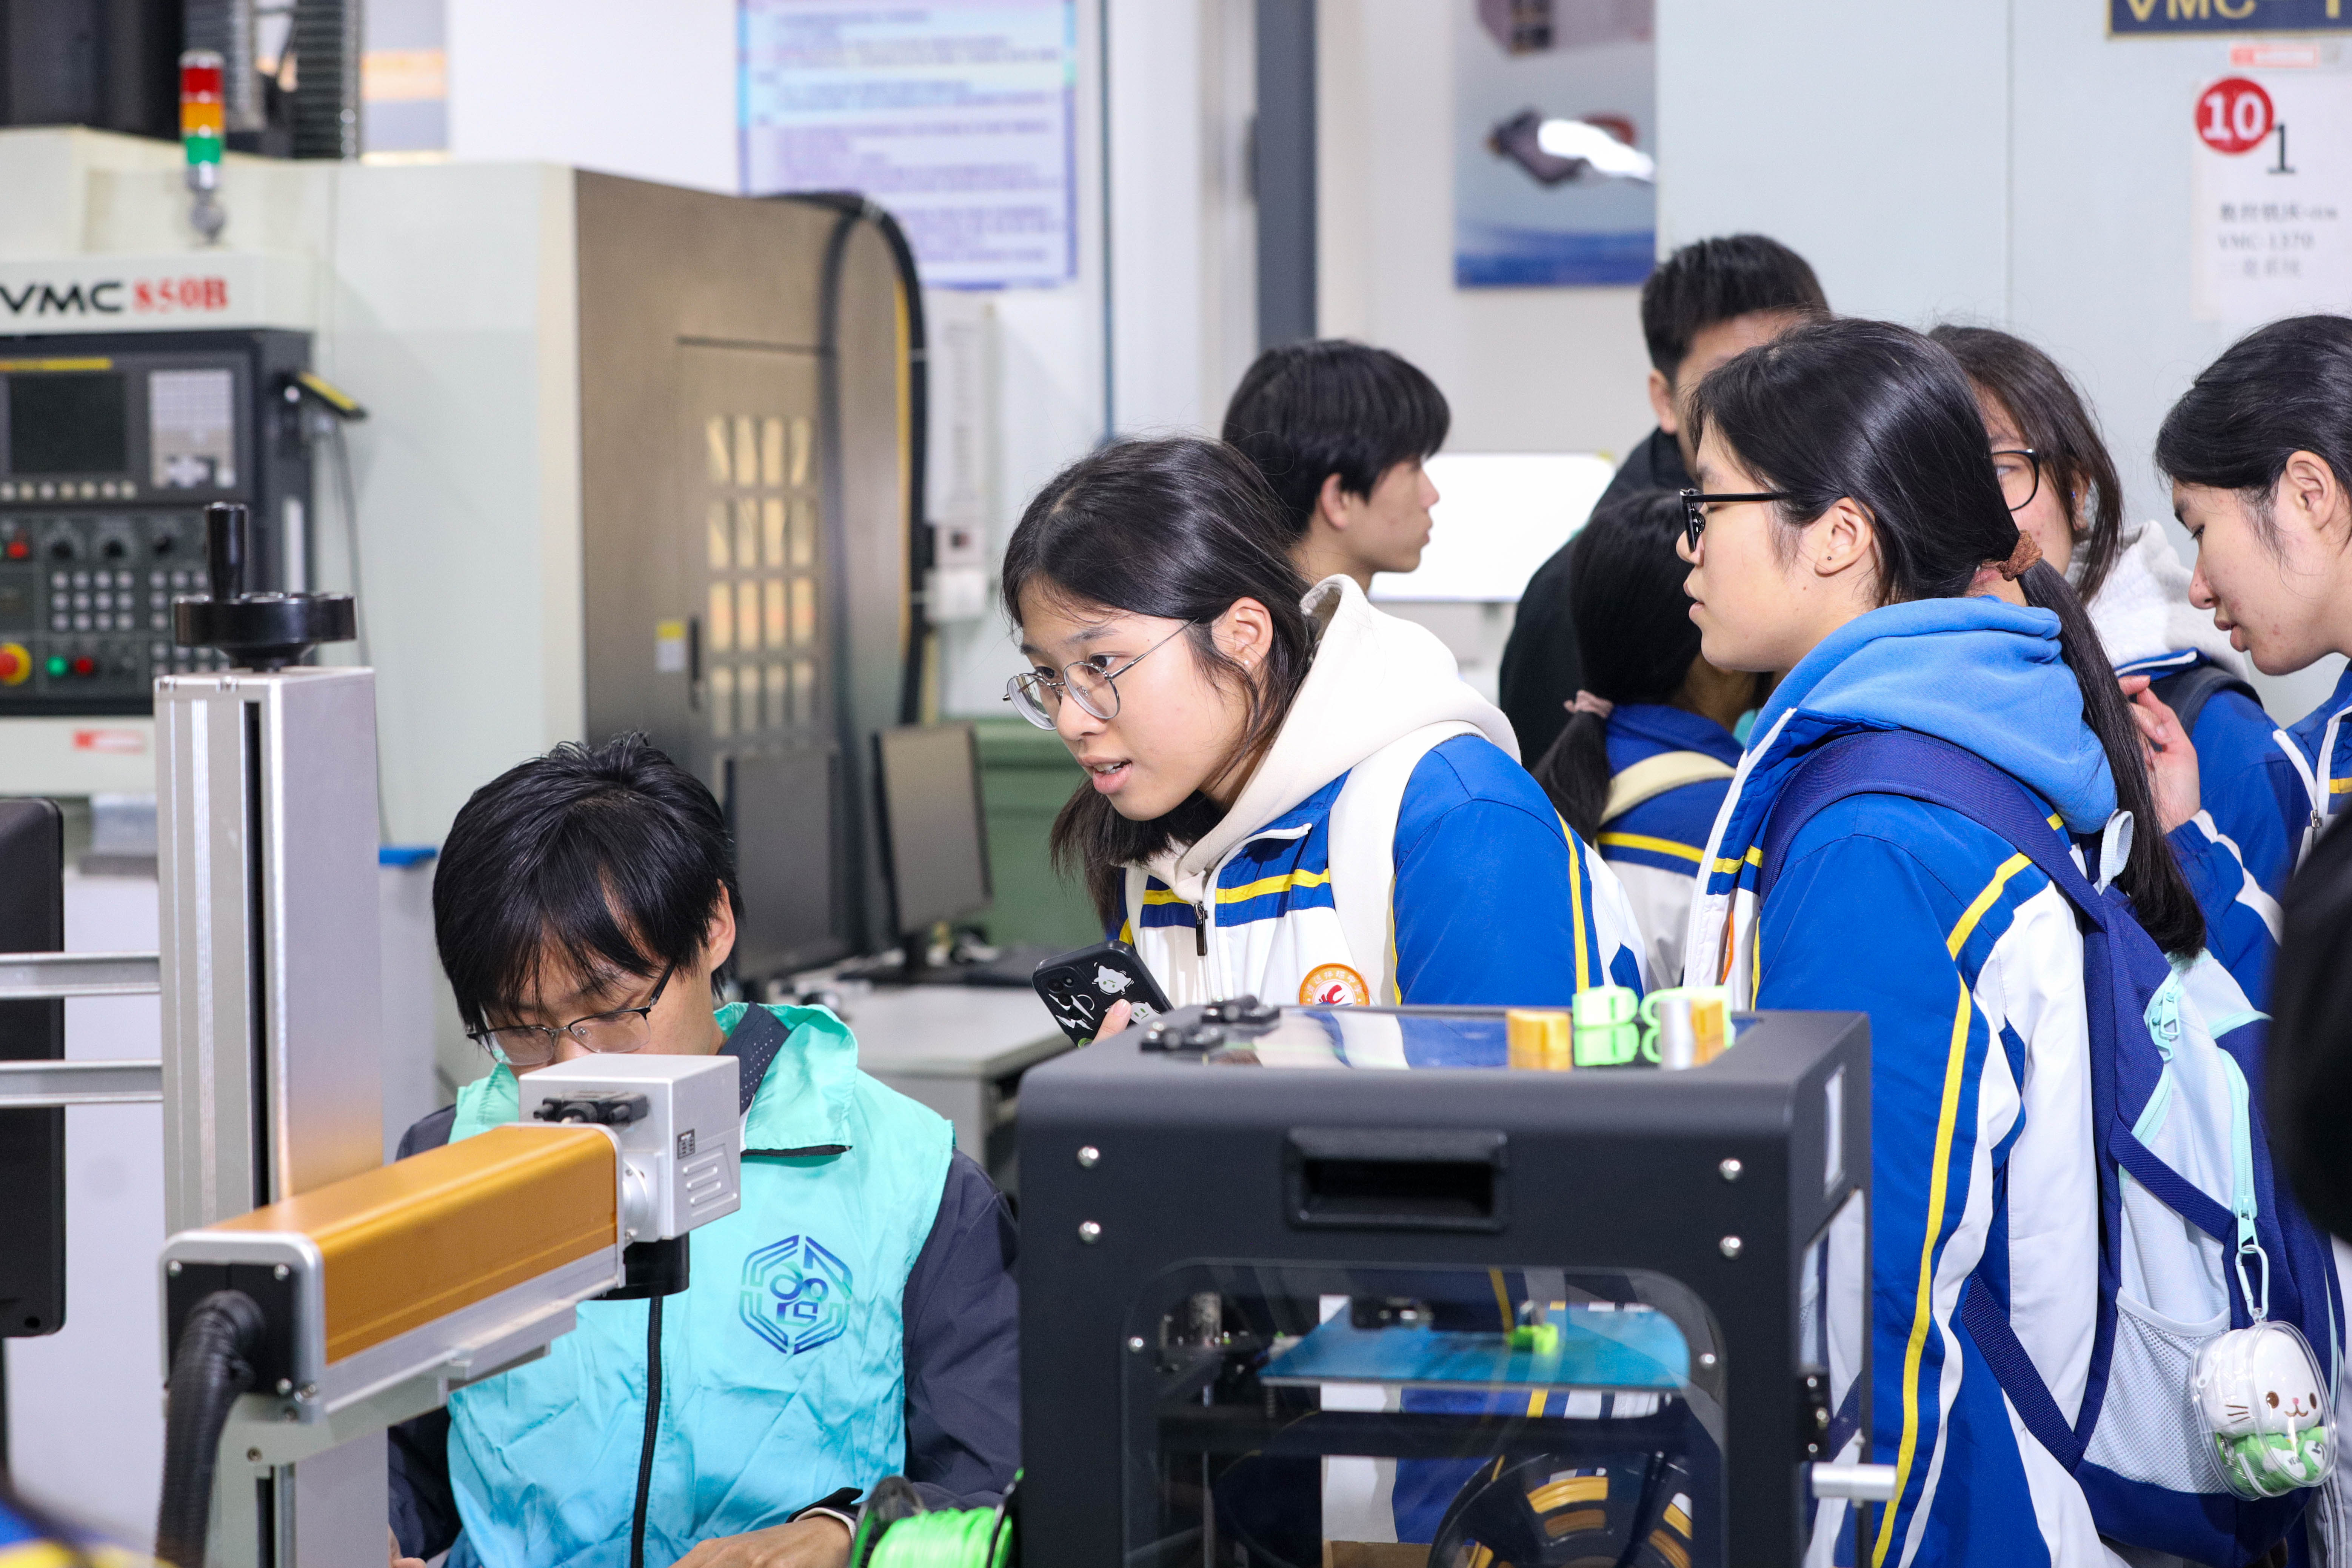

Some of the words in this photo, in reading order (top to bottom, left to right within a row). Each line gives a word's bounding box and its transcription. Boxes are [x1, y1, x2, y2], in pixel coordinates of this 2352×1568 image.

[2203, 93, 2264, 140] 10
[0, 280, 123, 314] VMC
[133, 277, 229, 314] 850B
